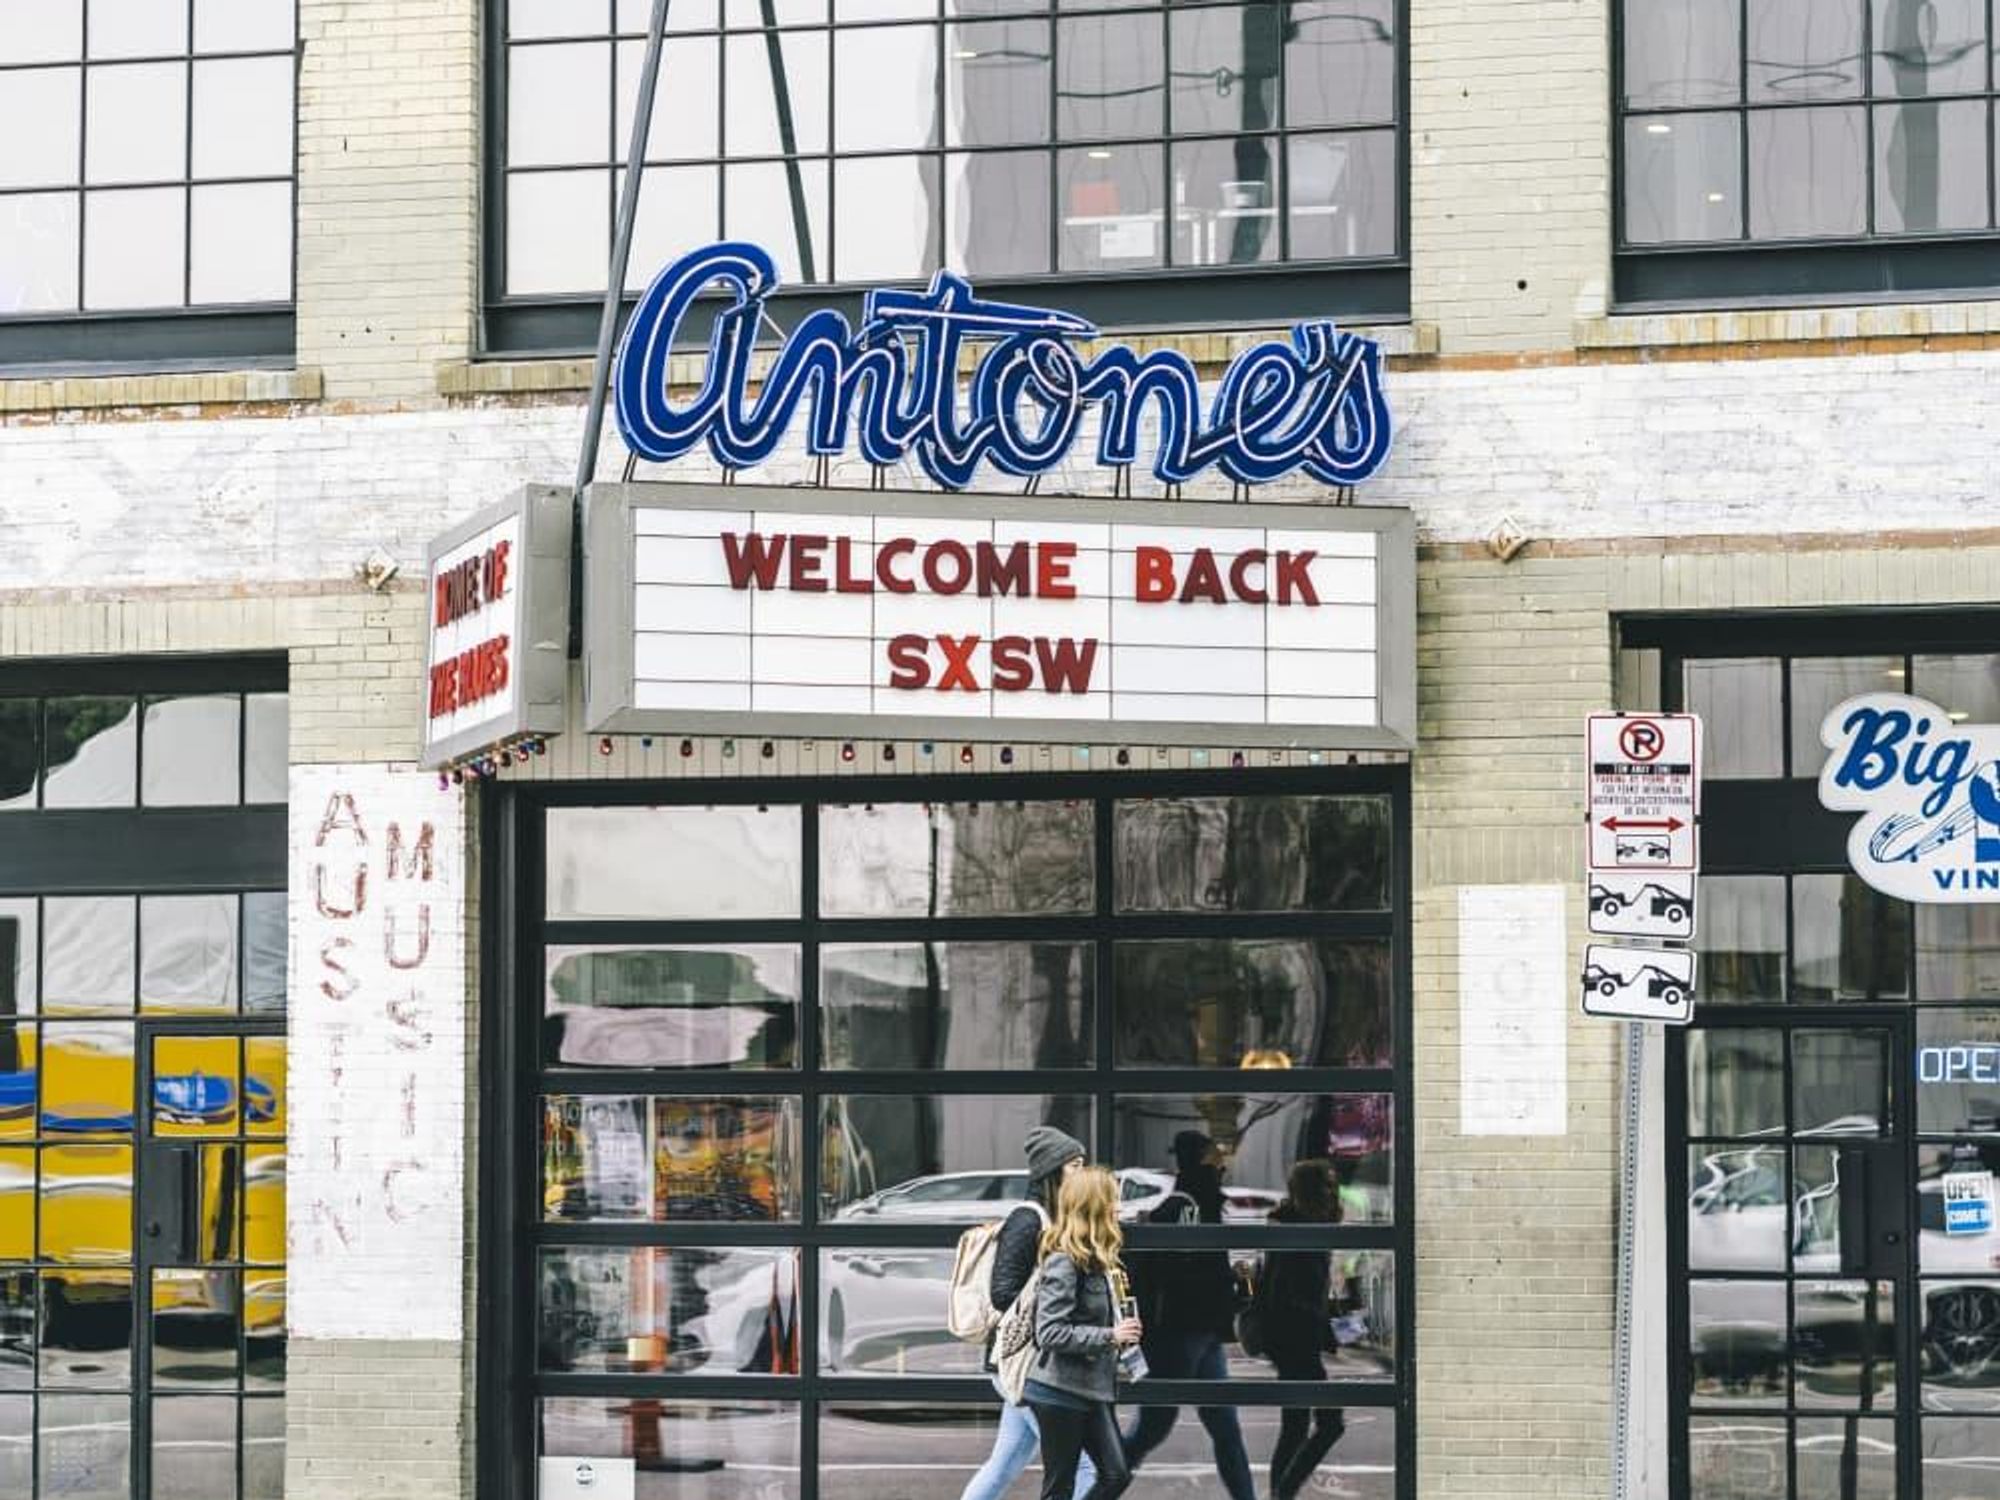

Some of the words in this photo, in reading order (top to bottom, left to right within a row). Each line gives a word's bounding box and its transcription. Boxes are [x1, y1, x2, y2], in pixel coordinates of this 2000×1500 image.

[720, 532, 1077, 600] WELCOME
[1135, 546, 1321, 607] BACK
[887, 635, 1098, 694] SXSW
[1834, 708, 1973, 819] Big
[1919, 1046, 2000, 1084] OPE
